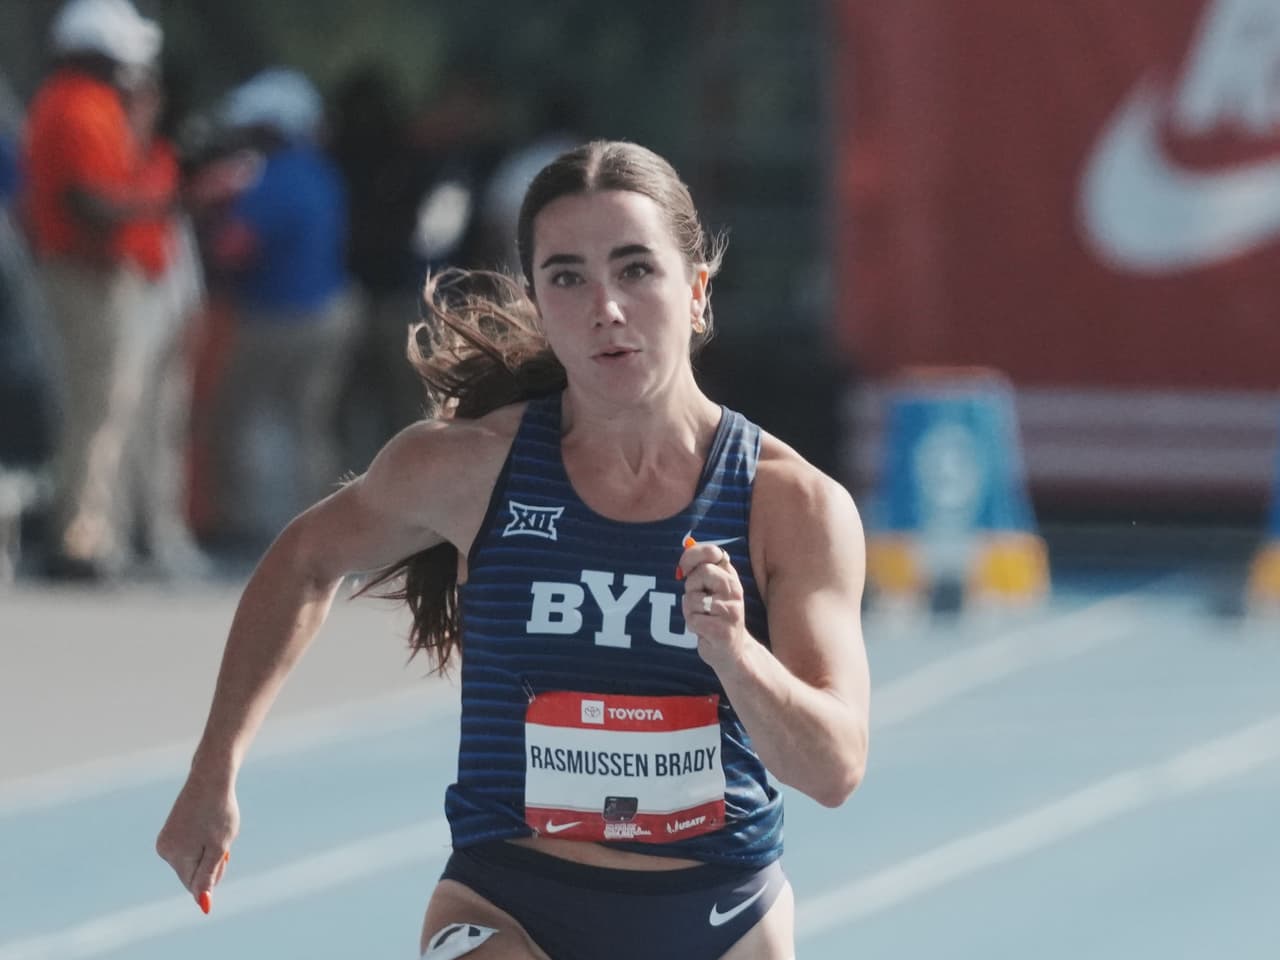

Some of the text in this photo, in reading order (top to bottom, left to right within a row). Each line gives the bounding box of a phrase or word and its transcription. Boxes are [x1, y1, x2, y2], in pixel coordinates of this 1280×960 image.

[526, 569, 699, 649] BYU
[607, 707, 664, 721] TOYOTA
[530, 745, 717, 777] RASMUSSEN BRADY
